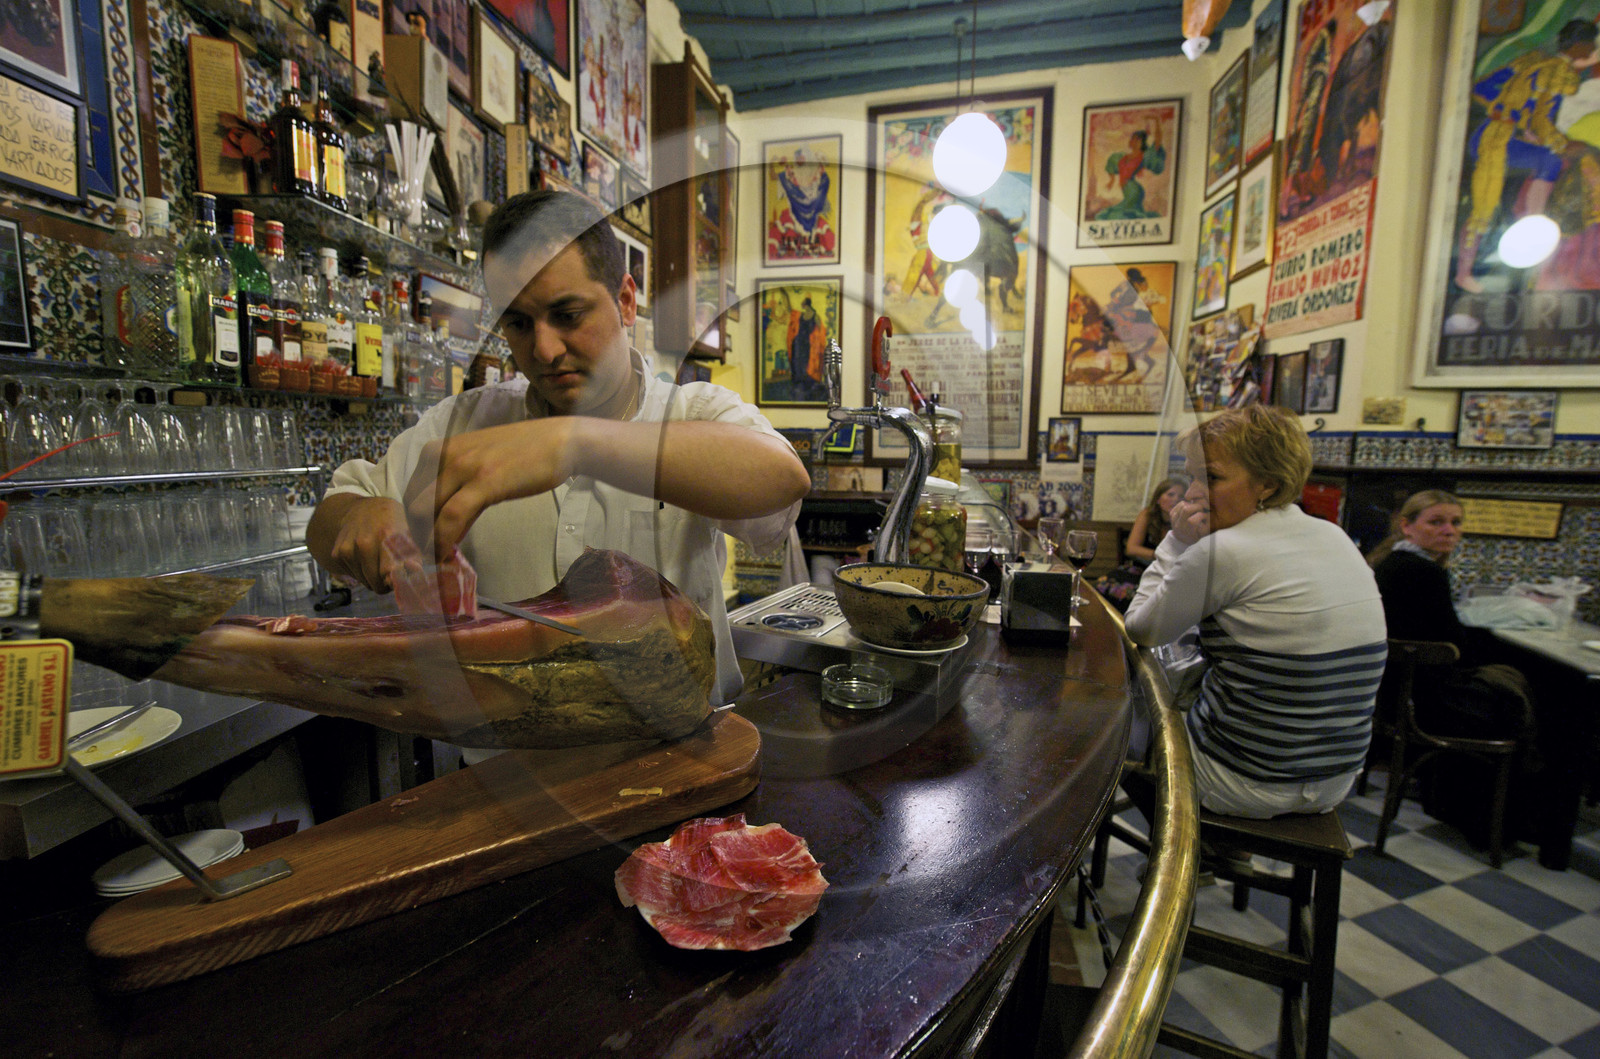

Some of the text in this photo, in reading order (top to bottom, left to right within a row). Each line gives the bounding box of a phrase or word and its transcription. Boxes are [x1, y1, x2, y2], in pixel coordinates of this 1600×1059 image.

[1088, 222, 1163, 237] SEVILLA
[1311, 229, 1364, 267] ROMERO
[1270, 255, 1361, 304] EMILIO MUÑOZ
[1451, 293, 1600, 332] CORD
[1447, 335, 1529, 360] FERIA
[1087, 383, 1142, 398] SEVILLA
[1016, 481, 1053, 491] SICAB
[38, 719, 53, 760] GABRIEL
